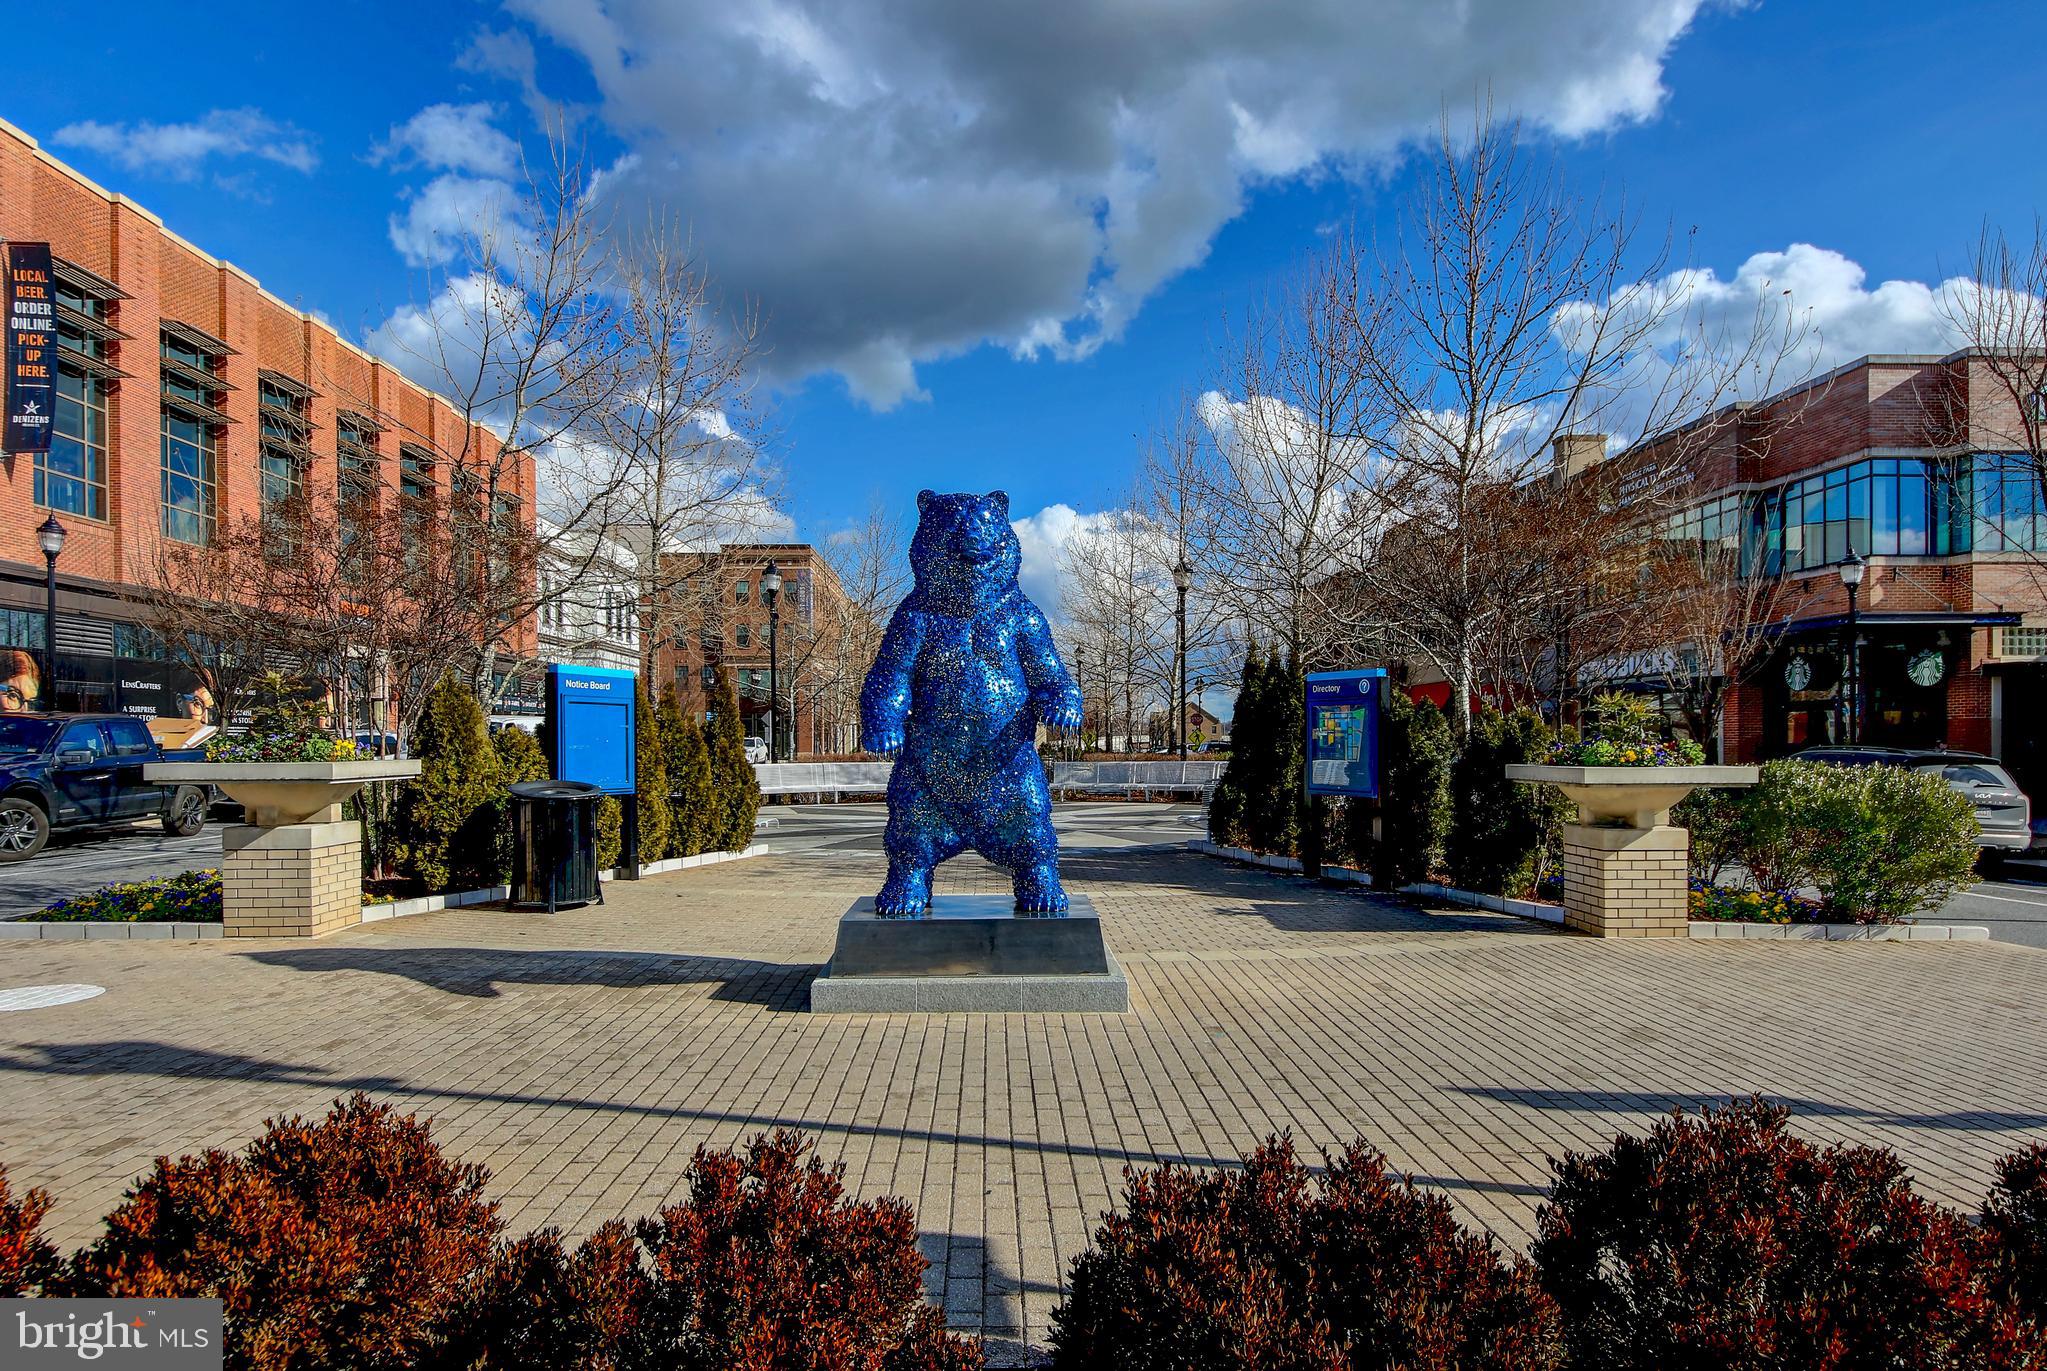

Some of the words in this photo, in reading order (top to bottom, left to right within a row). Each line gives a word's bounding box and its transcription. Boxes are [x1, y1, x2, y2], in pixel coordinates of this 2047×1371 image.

[14, 269, 49, 283] LOCAL
[16, 285, 48, 299] BEER.
[14, 301, 52, 315] ORDER
[11, 317, 56, 331] ONLINE.
[18, 333, 49, 346] PICK-
[26, 349, 41, 361] UP
[17, 364, 50, 378] HERE.
[12, 415, 50, 424] DENIZENS
[565, 679, 588, 689] Notice
[590, 681, 611, 690] Board
[1312, 685, 1341, 693] Directory
[122, 705, 128, 713] A
[128, 705, 157, 714] SURPRISE
